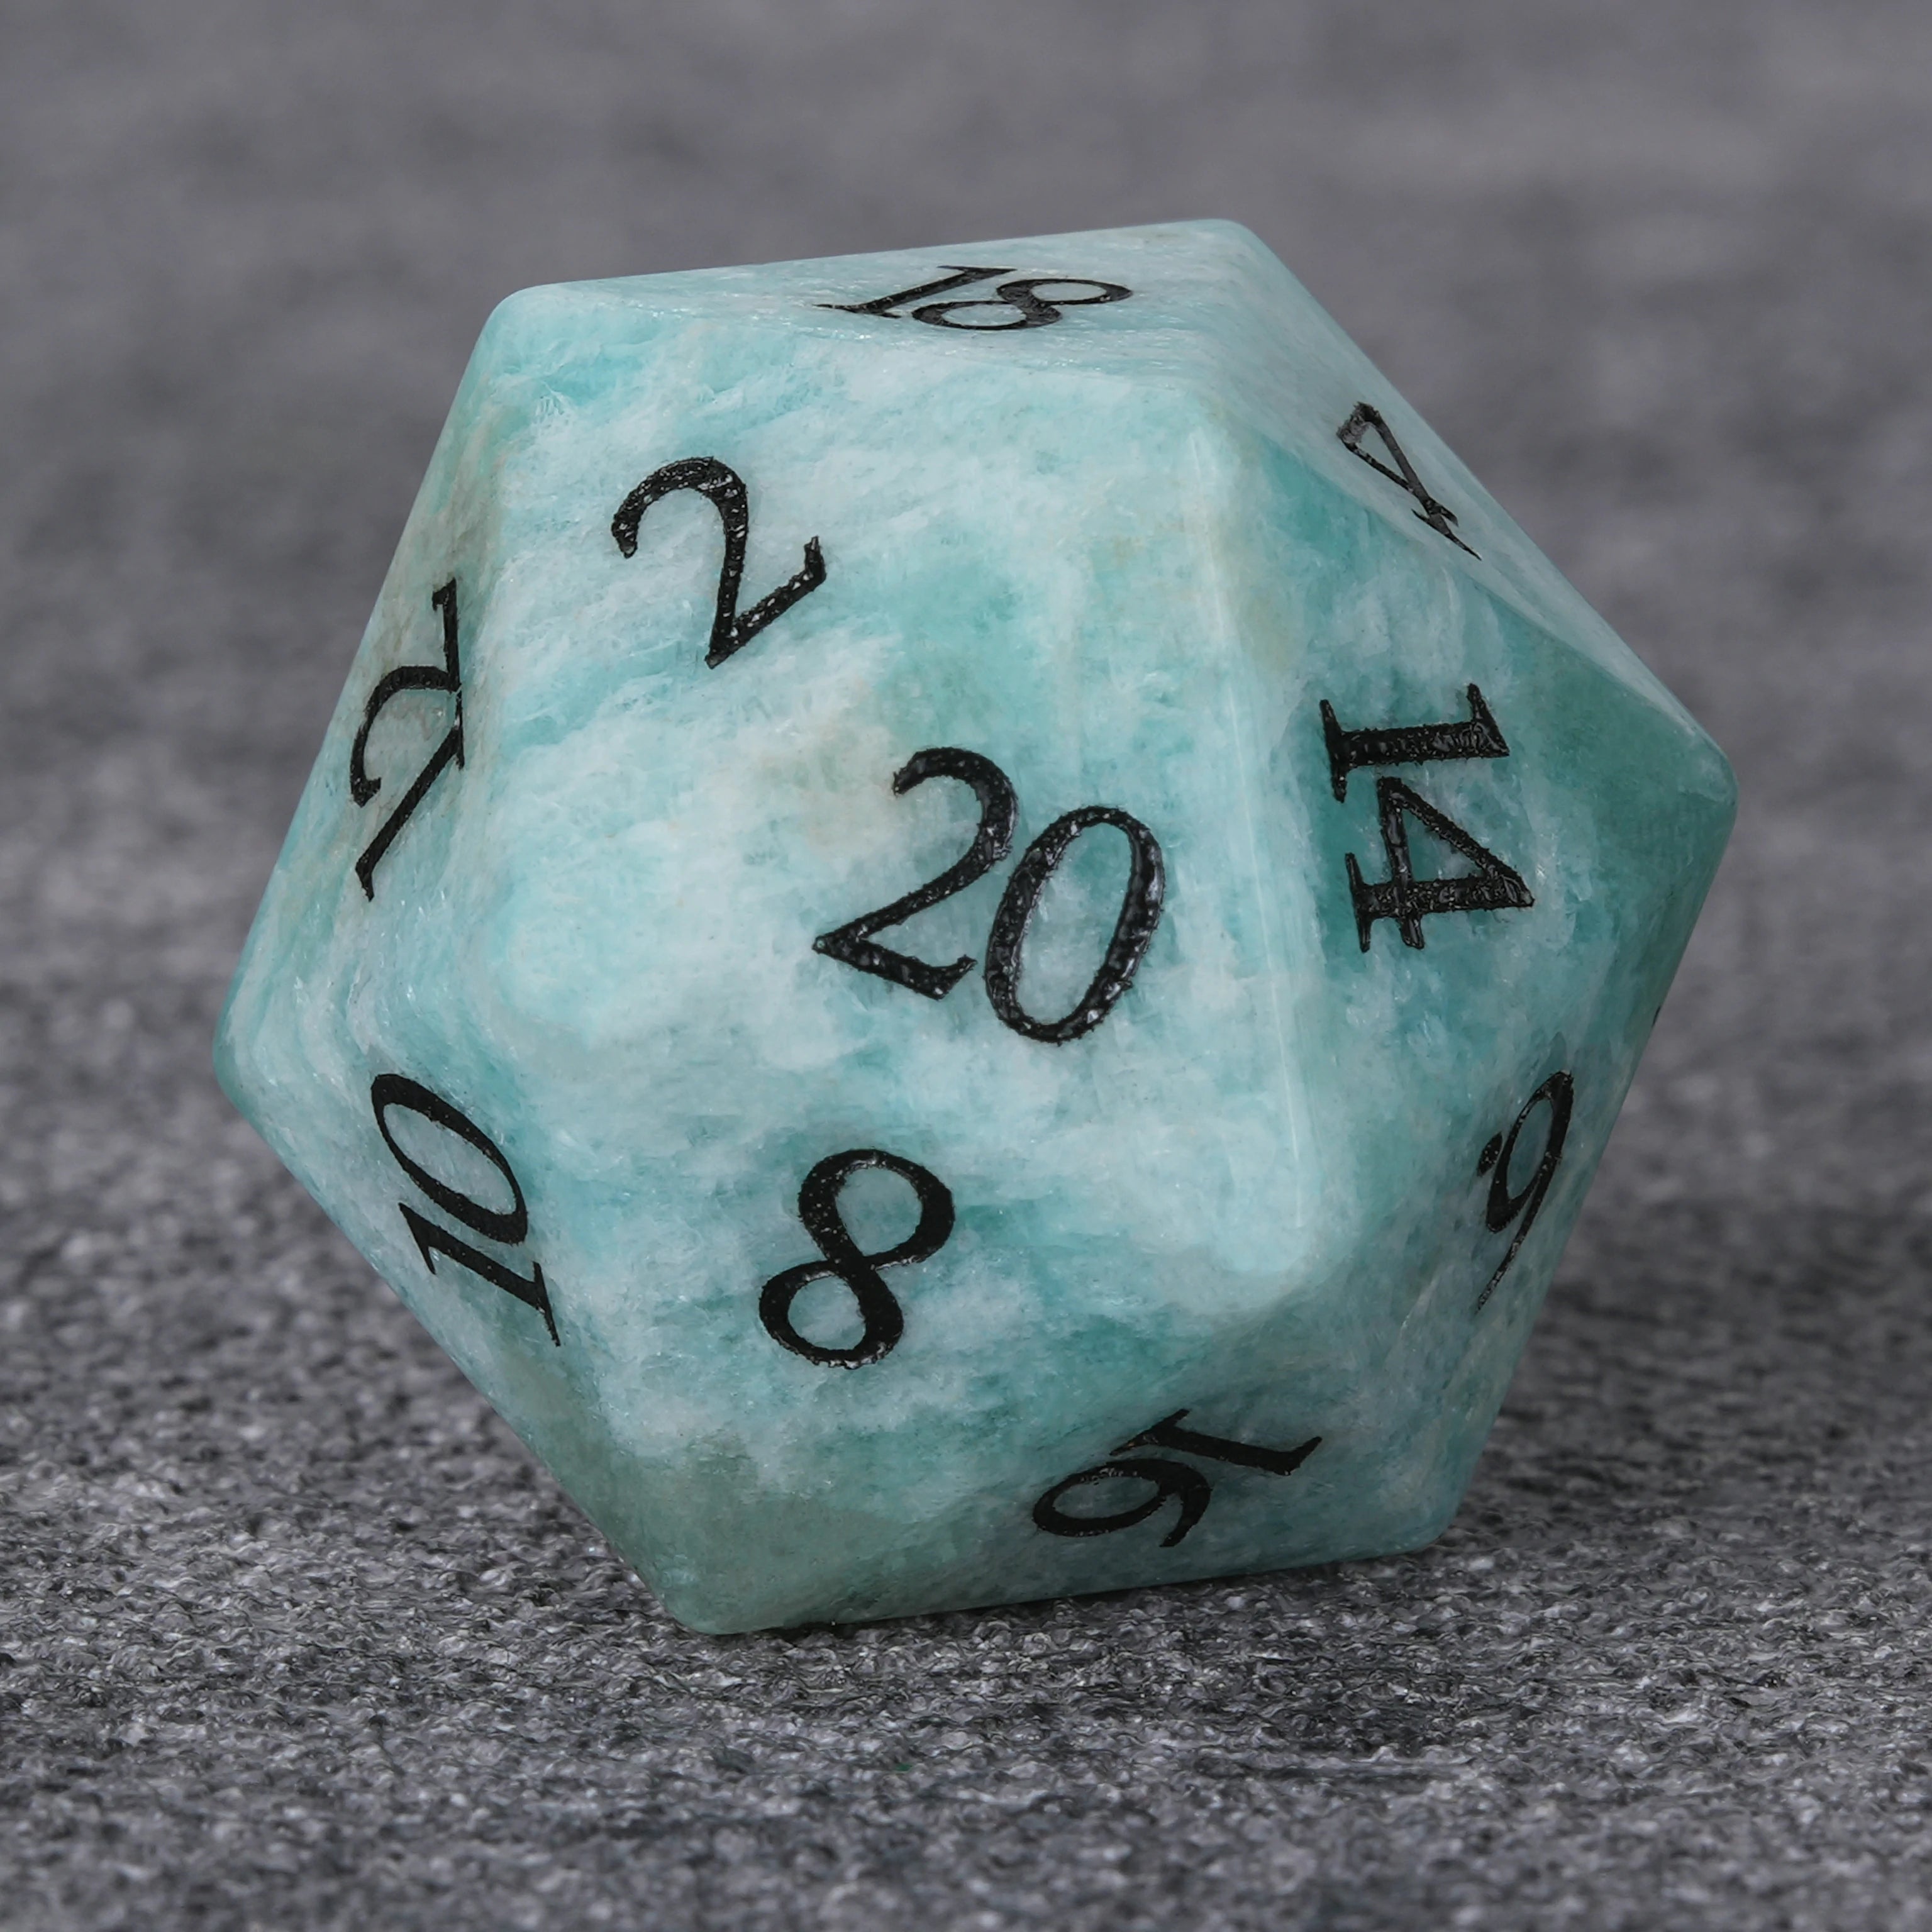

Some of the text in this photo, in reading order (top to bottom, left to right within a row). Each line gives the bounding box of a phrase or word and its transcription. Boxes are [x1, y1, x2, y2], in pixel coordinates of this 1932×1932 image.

[811, 265, 1133, 331] 18
[611, 455, 827, 670] 2
[349, 577, 465, 902] 12
[1319, 682, 1535, 955] 14
[813, 745, 1166, 1047] 20
[370, 1073, 561, 1348] 10
[758, 1145, 957, 1370] 8
[1031, 1408, 1323, 1547] 16
